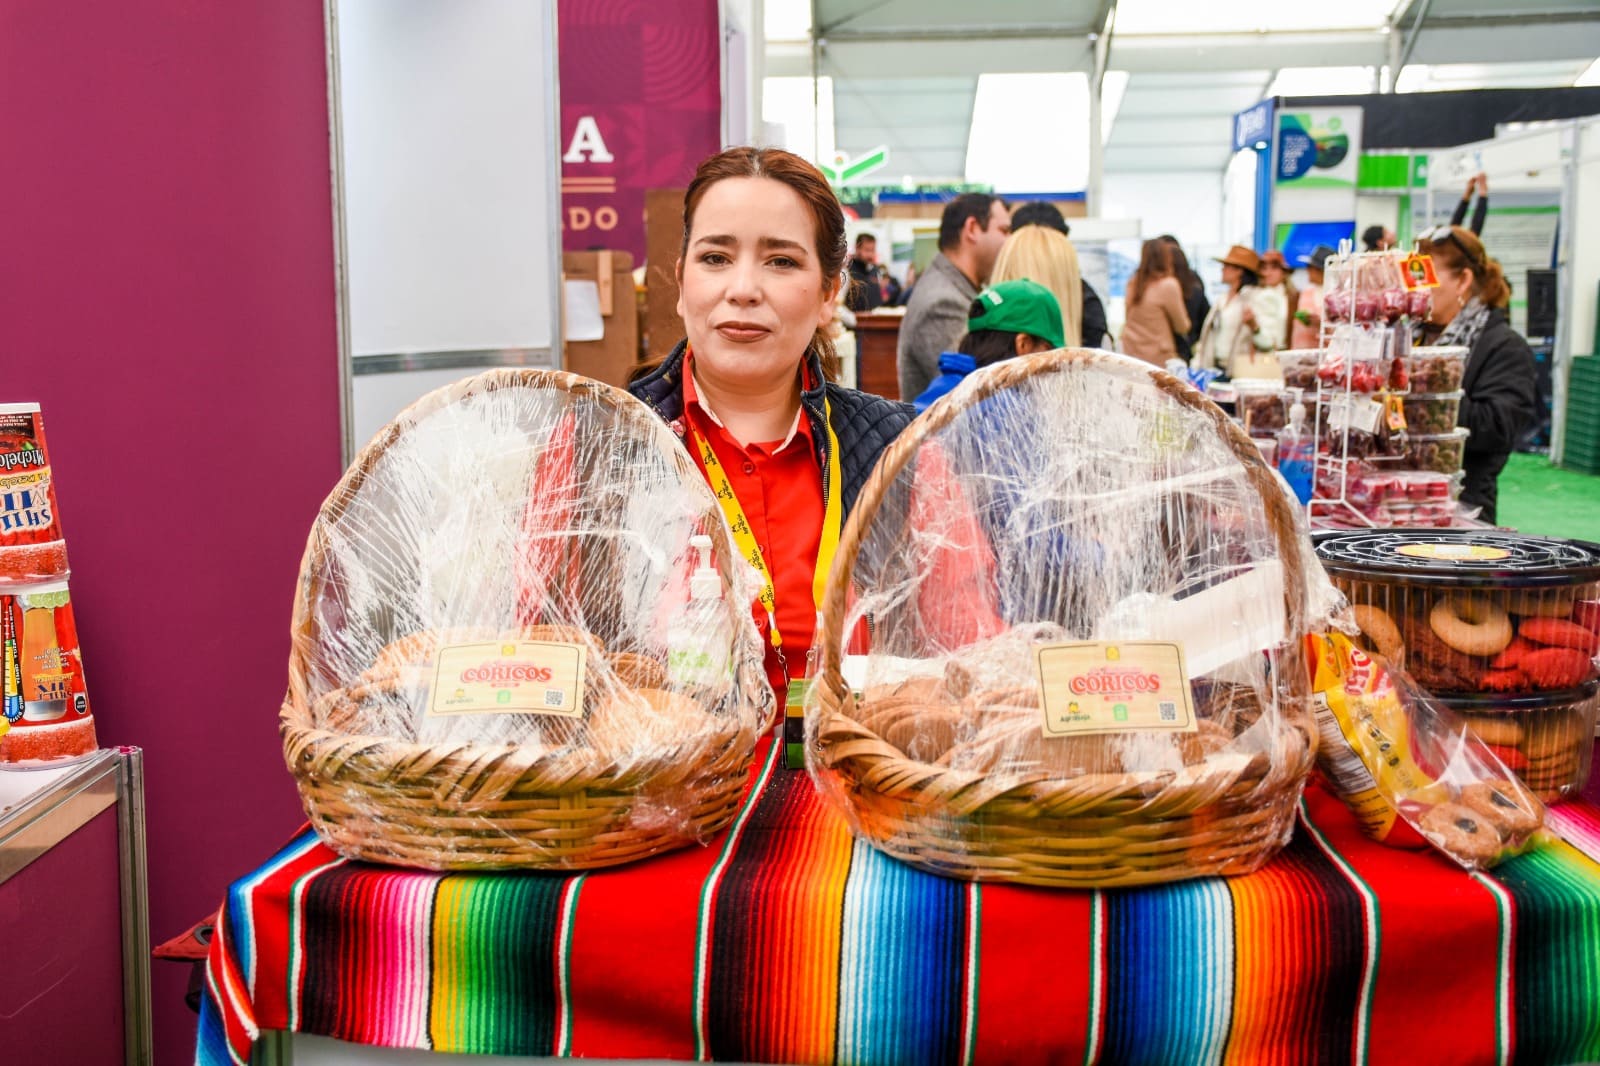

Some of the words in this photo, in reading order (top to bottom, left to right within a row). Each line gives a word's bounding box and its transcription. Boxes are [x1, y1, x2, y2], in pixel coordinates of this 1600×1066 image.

[562, 116, 614, 163] A
[562, 206, 619, 231] DO
[461, 666, 553, 683] CORICOS
[1069, 674, 1161, 694] CORICOS
